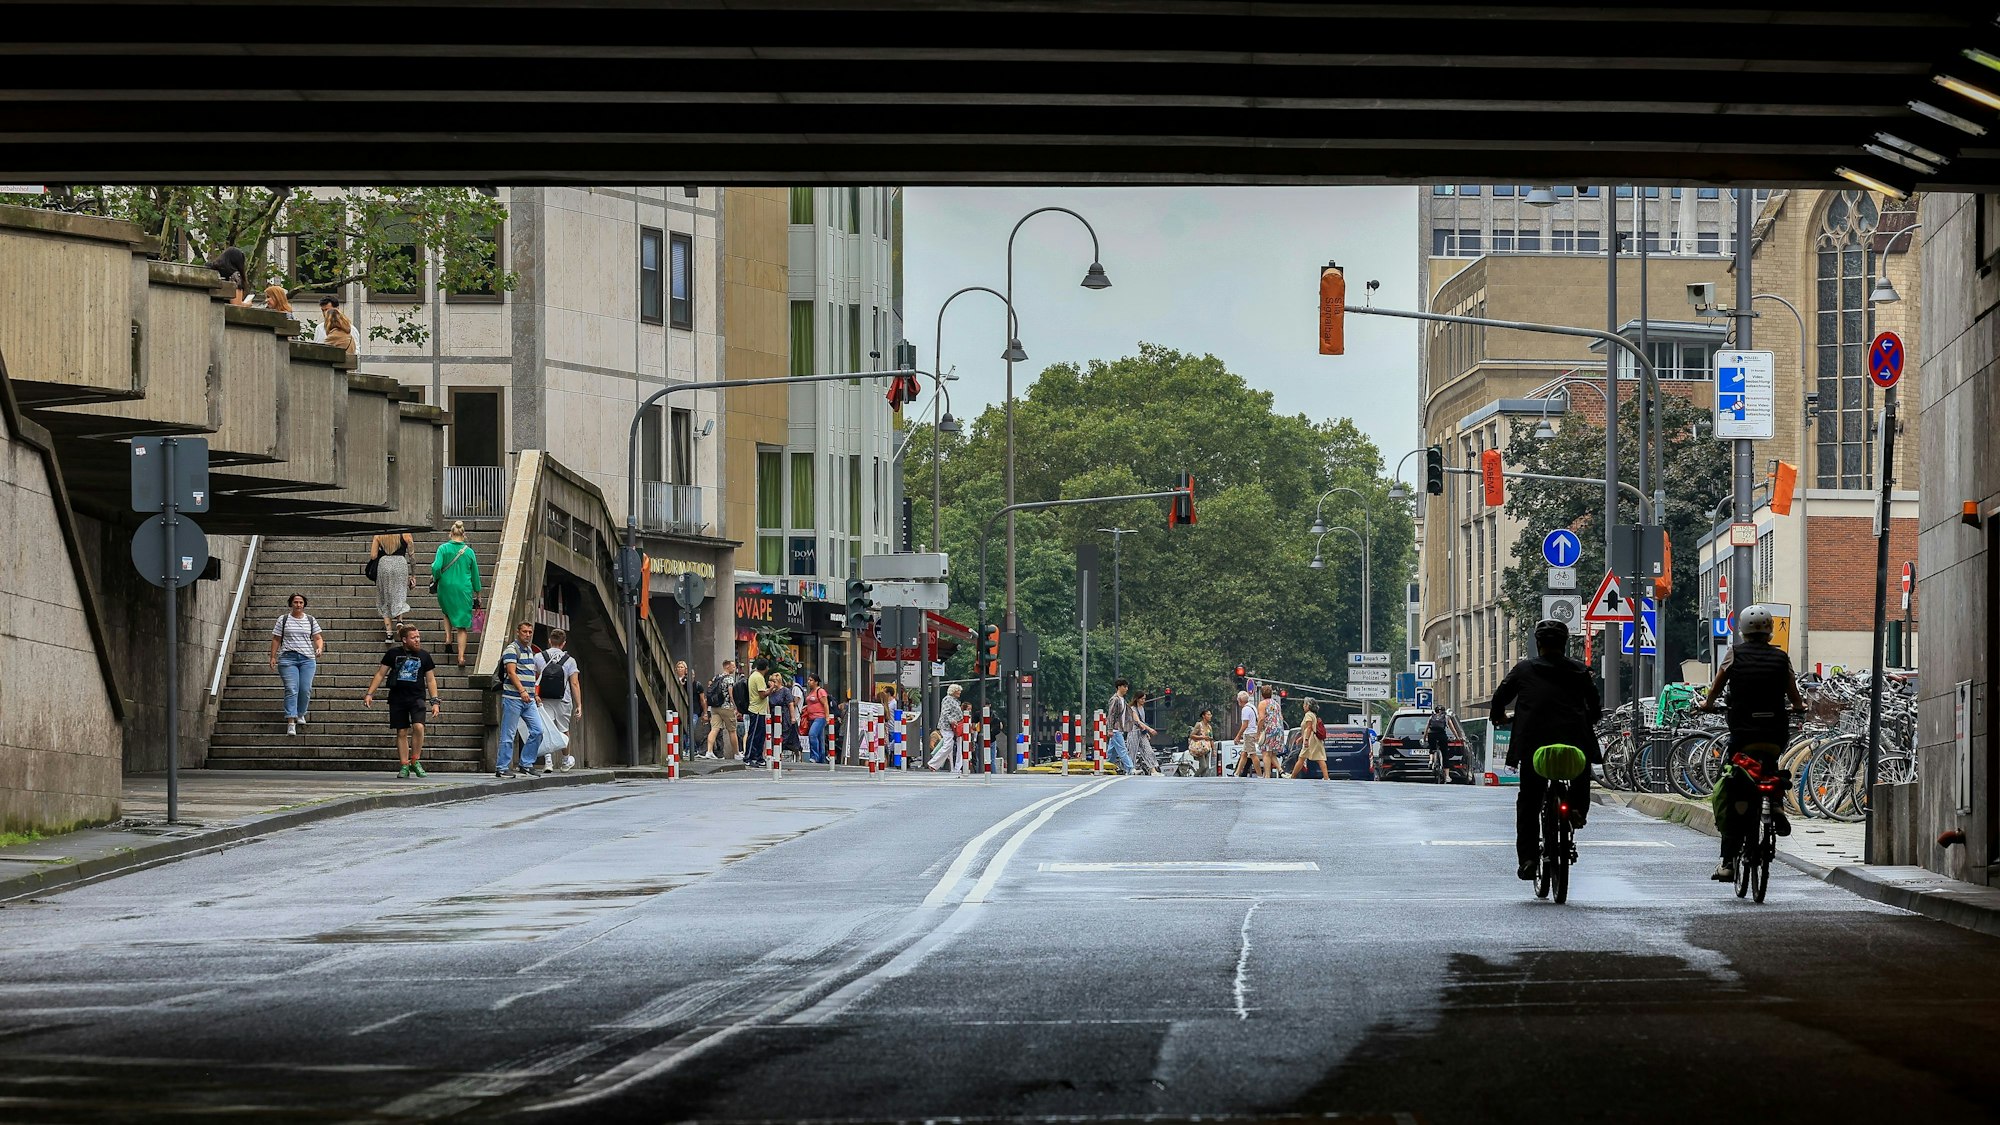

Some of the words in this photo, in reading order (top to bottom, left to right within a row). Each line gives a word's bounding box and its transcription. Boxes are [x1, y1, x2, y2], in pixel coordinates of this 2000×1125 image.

[1324, 297, 1334, 344] Signalbau
[1486, 462, 1495, 495] FABEMA
[794, 549, 816, 559] DOM
[745, 597, 773, 621] VAPE
[787, 600, 805, 624] DOM
[1716, 620, 1728, 635] U
